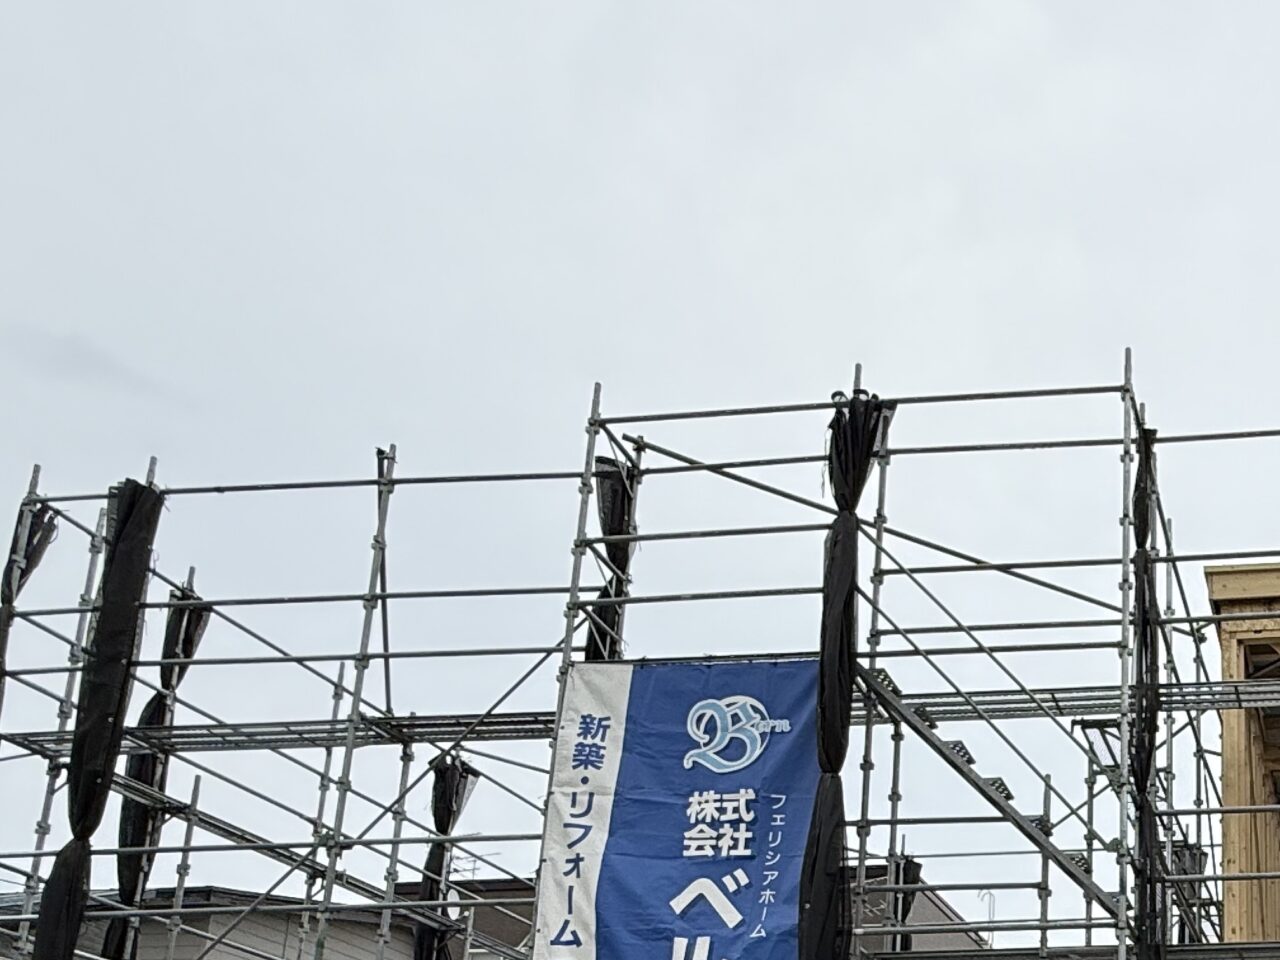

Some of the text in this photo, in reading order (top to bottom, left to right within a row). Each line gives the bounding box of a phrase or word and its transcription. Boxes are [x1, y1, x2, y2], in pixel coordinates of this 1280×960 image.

[750, 794, 787, 938] フェリシアホーム
